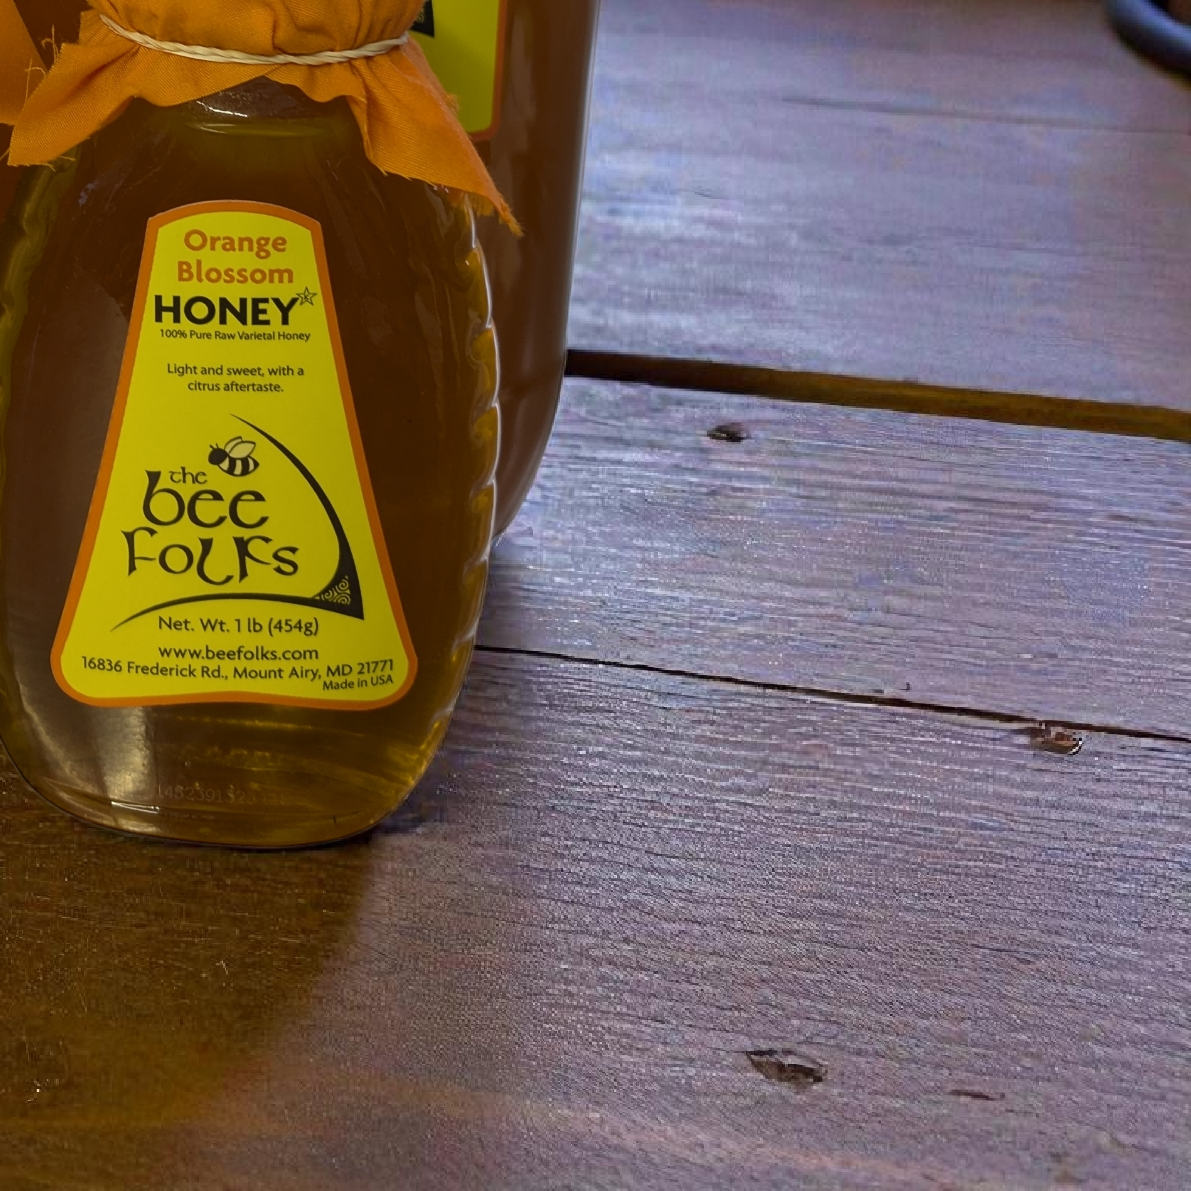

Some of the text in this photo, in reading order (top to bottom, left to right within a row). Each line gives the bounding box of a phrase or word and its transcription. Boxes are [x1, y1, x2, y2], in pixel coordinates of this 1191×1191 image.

[184, 229, 287, 260] Orange
[177, 260, 294, 284] Blossom
[154, 294, 299, 326] HONEY
[160, 329, 310, 342] 100% Pure Raw Varietal Honey
[167, 363, 304, 377] Light and sweet, with a
[188, 381, 284, 392] citrus aftertaste.
[169, 467, 208, 484] the
[142, 470, 269, 529] bee
[121, 526, 299, 586] folks
[158, 616, 319, 637] Net. Wt. 1 lb (454g)
[158, 645, 319, 661] www.beefolks.com
[81, 656, 394, 681] 16836 Frederick Rd., Mount Airy, MD 21771
[322, 674, 394, 691] Made in USA
